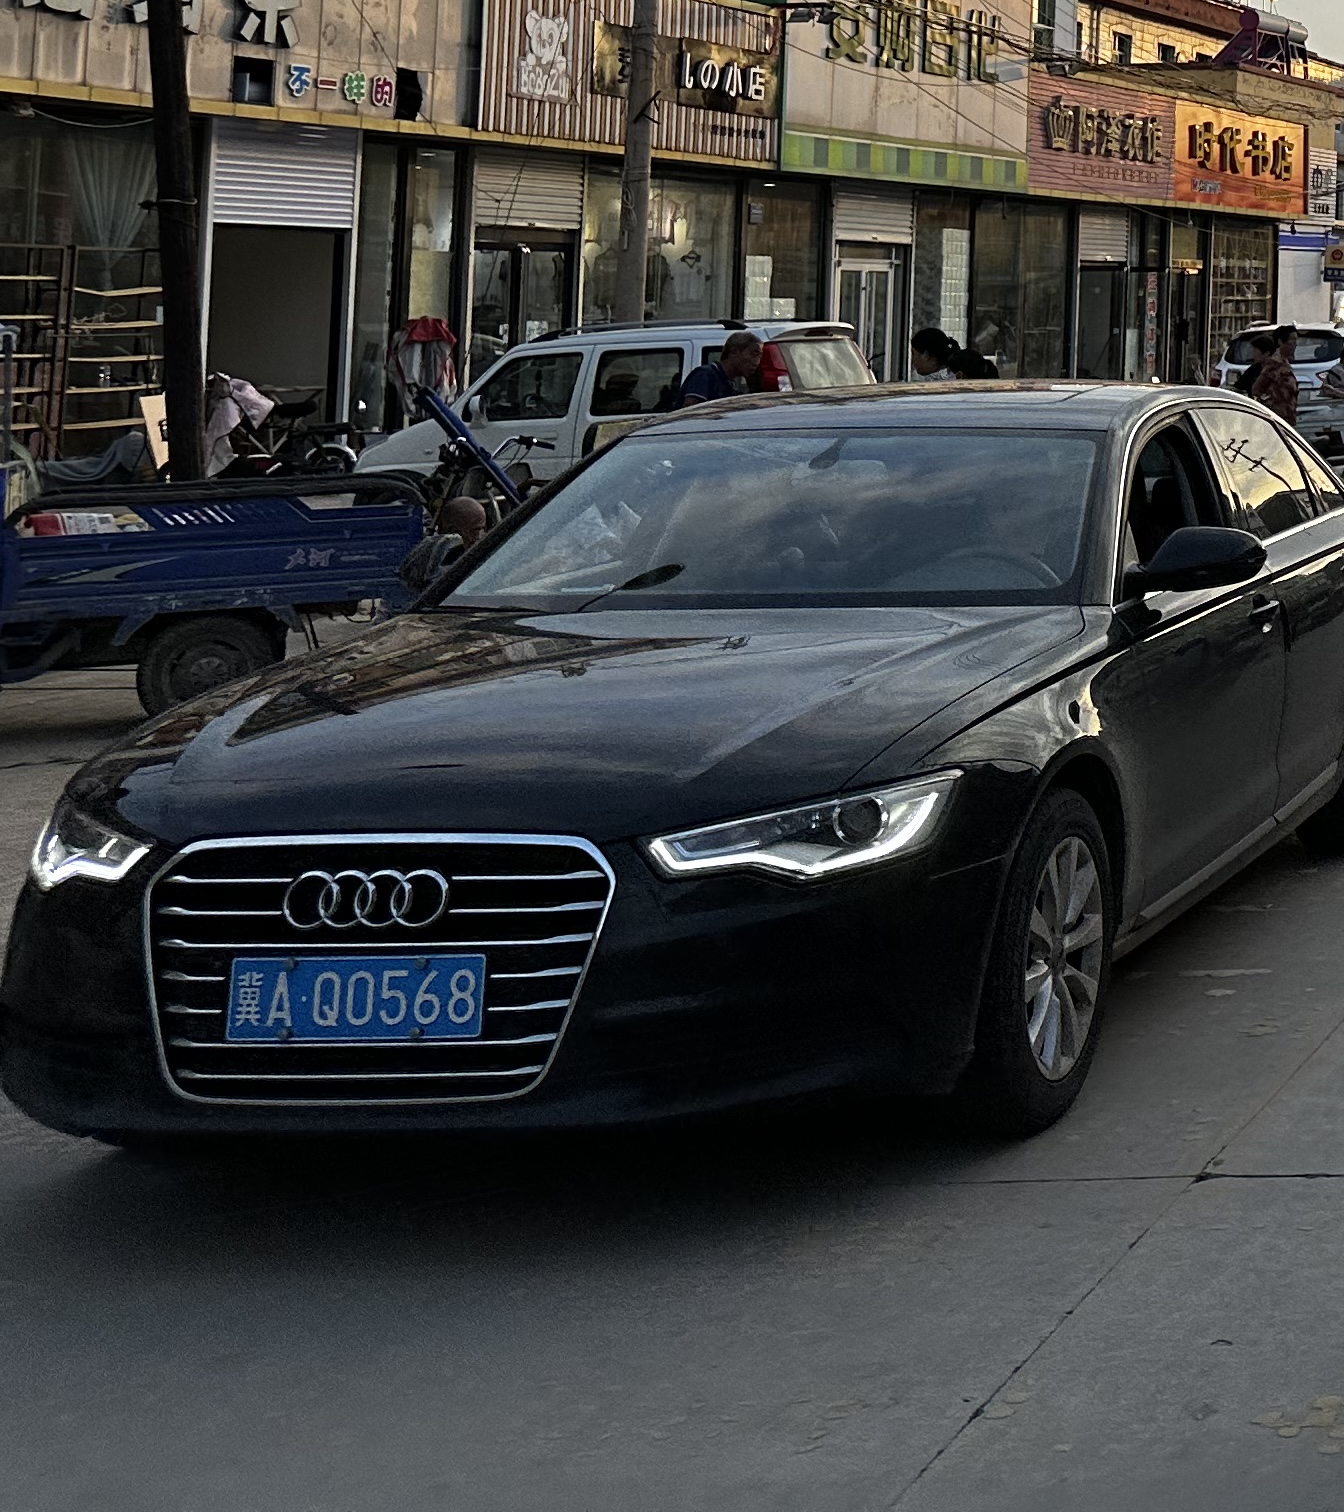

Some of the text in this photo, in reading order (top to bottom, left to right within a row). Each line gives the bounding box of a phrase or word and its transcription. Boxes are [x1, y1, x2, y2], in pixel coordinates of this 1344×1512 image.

[288, 64, 395, 107] 不一样的
[1188, 121, 1295, 181] 时代书店
